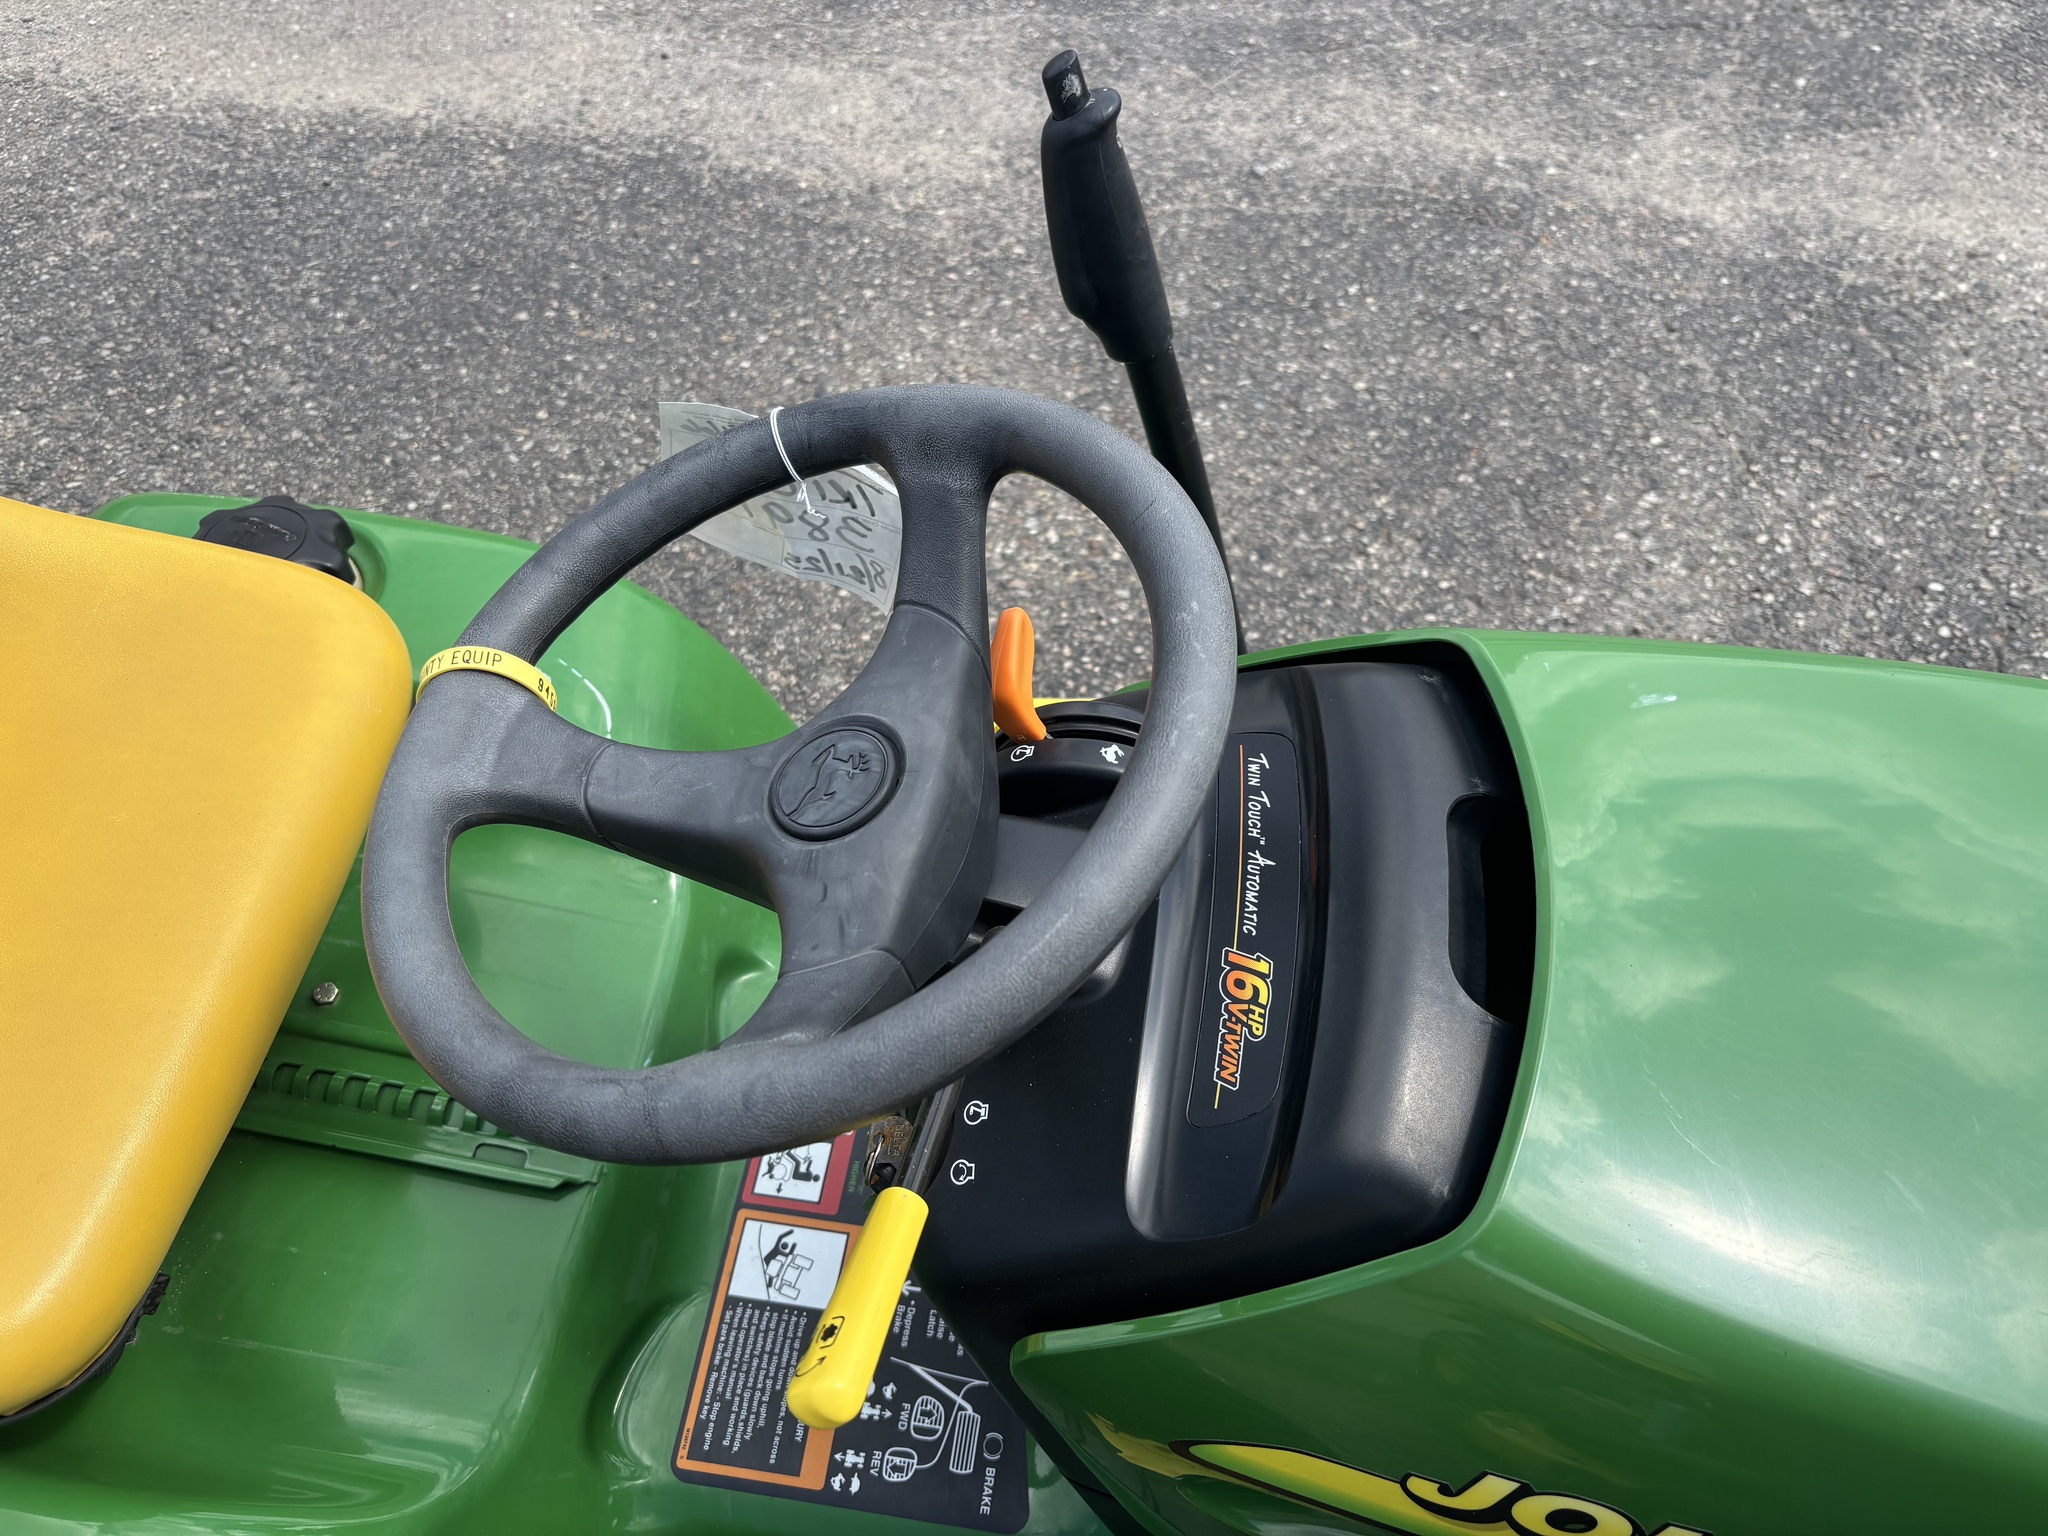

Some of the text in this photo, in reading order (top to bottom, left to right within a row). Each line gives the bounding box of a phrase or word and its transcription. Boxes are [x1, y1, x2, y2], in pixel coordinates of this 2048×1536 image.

[451, 649, 503, 667] EQUIP
[1226, 951, 1270, 1006] 16
[1247, 1004, 1265, 1036] HP
[1220, 1003, 1249, 1083] V-TWIN
[847, 1161, 860, 1192] HIGHER
[732, 1306, 743, 1328] When
[741, 1308, 752, 1328] Read
[759, 1311, 770, 1331] Keep
[796, 1316, 807, 1337] Drive
[893, 1304, 906, 1334] Brake
[901, 1306, 916, 1347] Depress
[926, 1309, 938, 1338] Latch
[936, 1317, 947, 1339] aise
[723, 1329, 738, 1357] leaving
[753, 1331, 764, 1356] safety
[773, 1320, 786, 1354] machine
[793, 1338, 800, 1349] up
[699, 1309, 733, 1419] Set park brake Remove key
[768, 1354, 778, 1377] stops
[775, 1315, 798, 1390] Avoid sudden turns
[790, 1349, 798, 1365] and
[722, 1308, 760, 1446] and switches) in place and working
[724, 1370, 736, 1399] manual
[743, 1312, 778, 1440] stop blade and back down slowly
[747, 1356, 759, 1387] devices
[761, 1378, 773, 1401] going
[709, 1401, 721, 1421] Stop
[756, 1402, 767, 1428] uphill,
[898, 1402, 911, 1430] FWD
[703, 1422, 714, 1450] engine
[775, 1420, 783, 1434] not
[795, 1419, 805, 1442] URY
[769, 1435, 780, 1464] across
[869, 1450, 883, 1477] REV
[979, 1467, 996, 1515] BRAKE
[1401, 1469, 1714, 1536] JO
